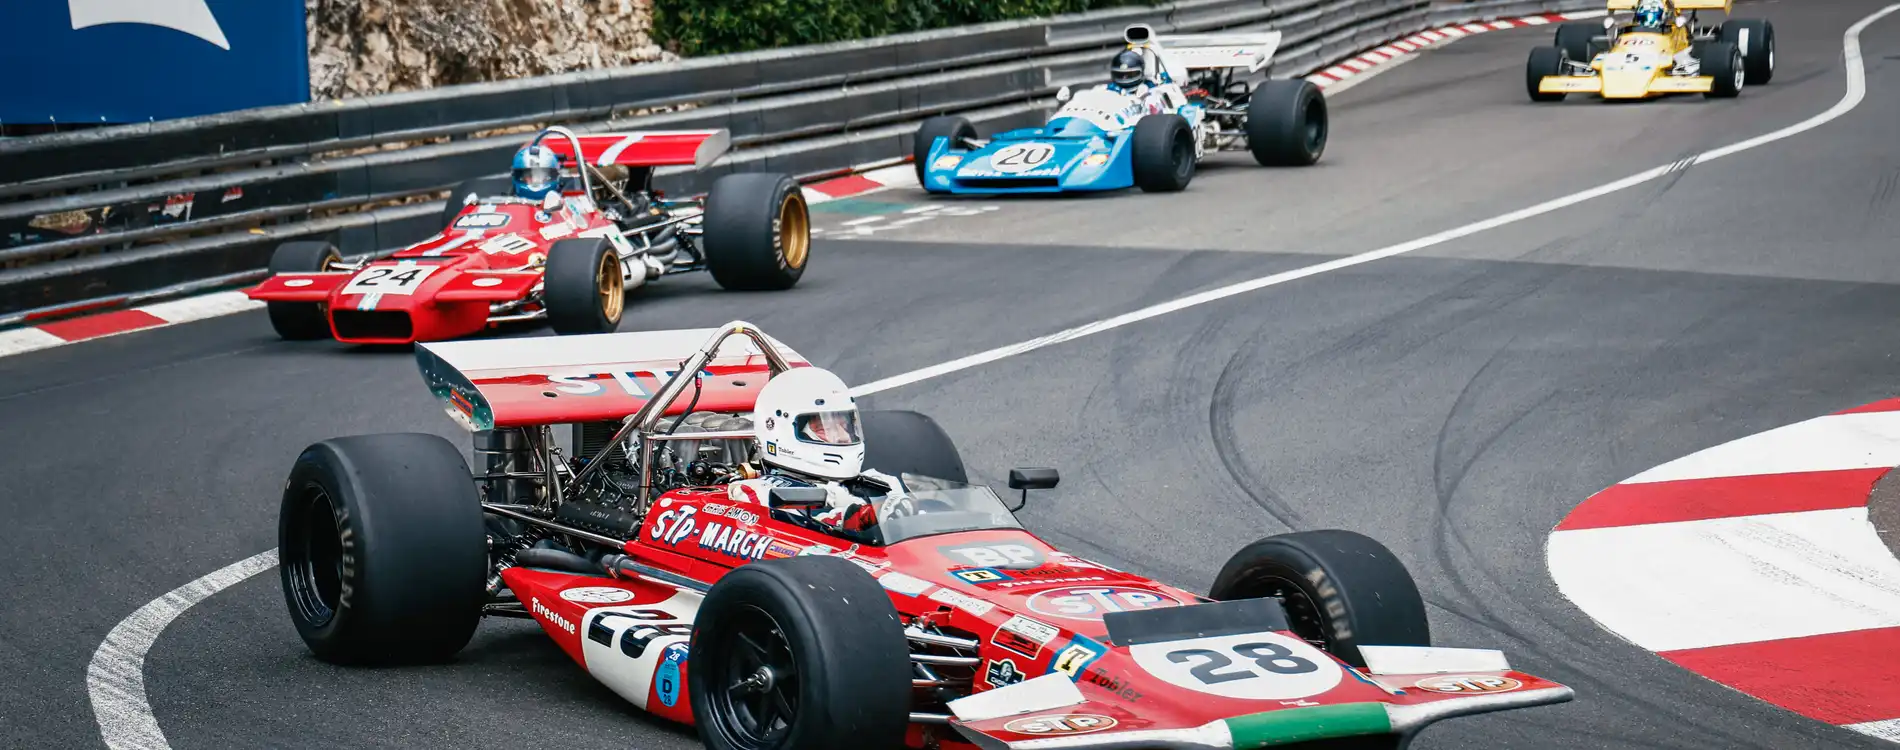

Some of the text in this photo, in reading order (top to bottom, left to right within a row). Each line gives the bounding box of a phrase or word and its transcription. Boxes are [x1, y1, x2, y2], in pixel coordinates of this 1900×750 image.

[997, 147, 1052, 166] 20
[355, 268, 423, 287] 24
[725, 507, 760, 526] AMON
[949, 544, 1037, 567] BP
[966, 571, 989, 581] T
[1049, 587, 1164, 614] STP
[531, 596, 576, 636] Firestone
[669, 650, 681, 661] 28
[1165, 642, 1319, 686] 28
[1060, 647, 1144, 703] T Tobler
[1432, 677, 1506, 692] STP
[662, 678, 673, 694] D
[664, 693, 673, 706] 28
[1020, 716, 1101, 733] STP
